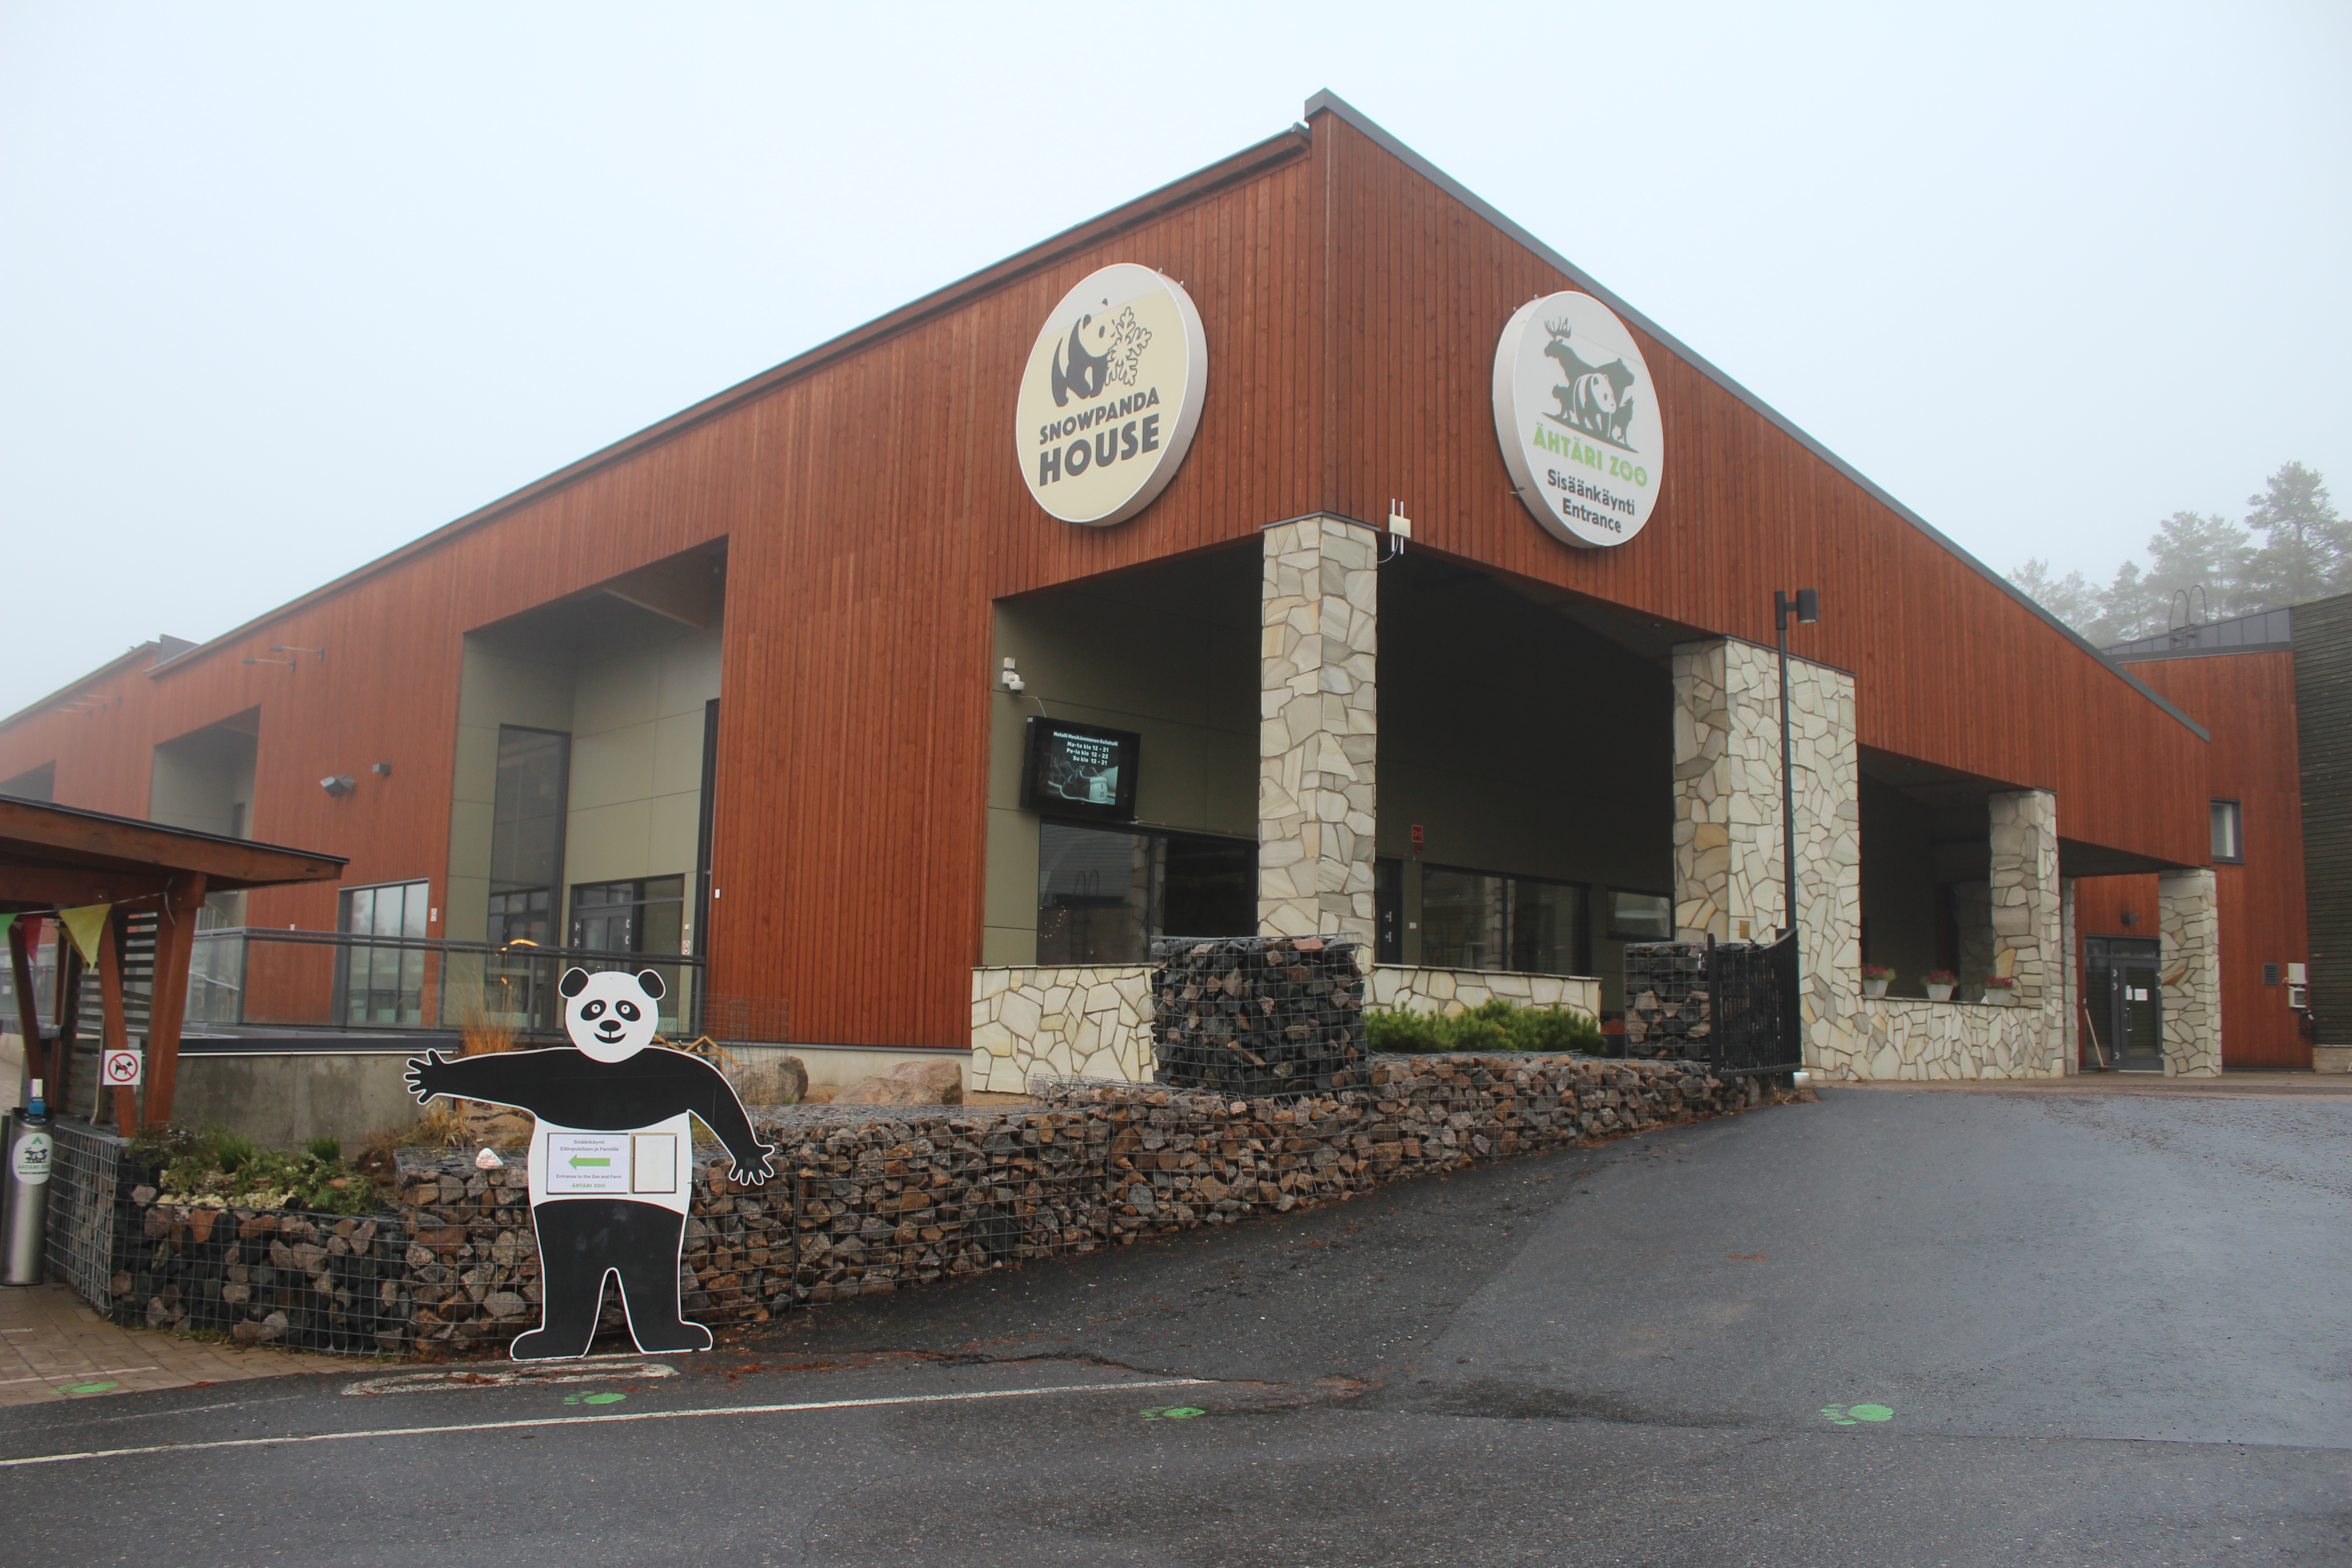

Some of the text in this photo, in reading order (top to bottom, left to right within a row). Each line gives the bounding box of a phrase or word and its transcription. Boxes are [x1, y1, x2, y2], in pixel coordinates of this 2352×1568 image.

[1039, 387, 1160, 445] SNOWPANDA
[1039, 413, 1159, 486] HOUSE
[1533, 421, 1648, 487] ÄHTÄRI ZOO
[1548, 469, 1636, 515] Sisäänkäynti
[1563, 497, 1622, 533] Entrance
[1068, 734, 1099, 743] Mesikämmenen
